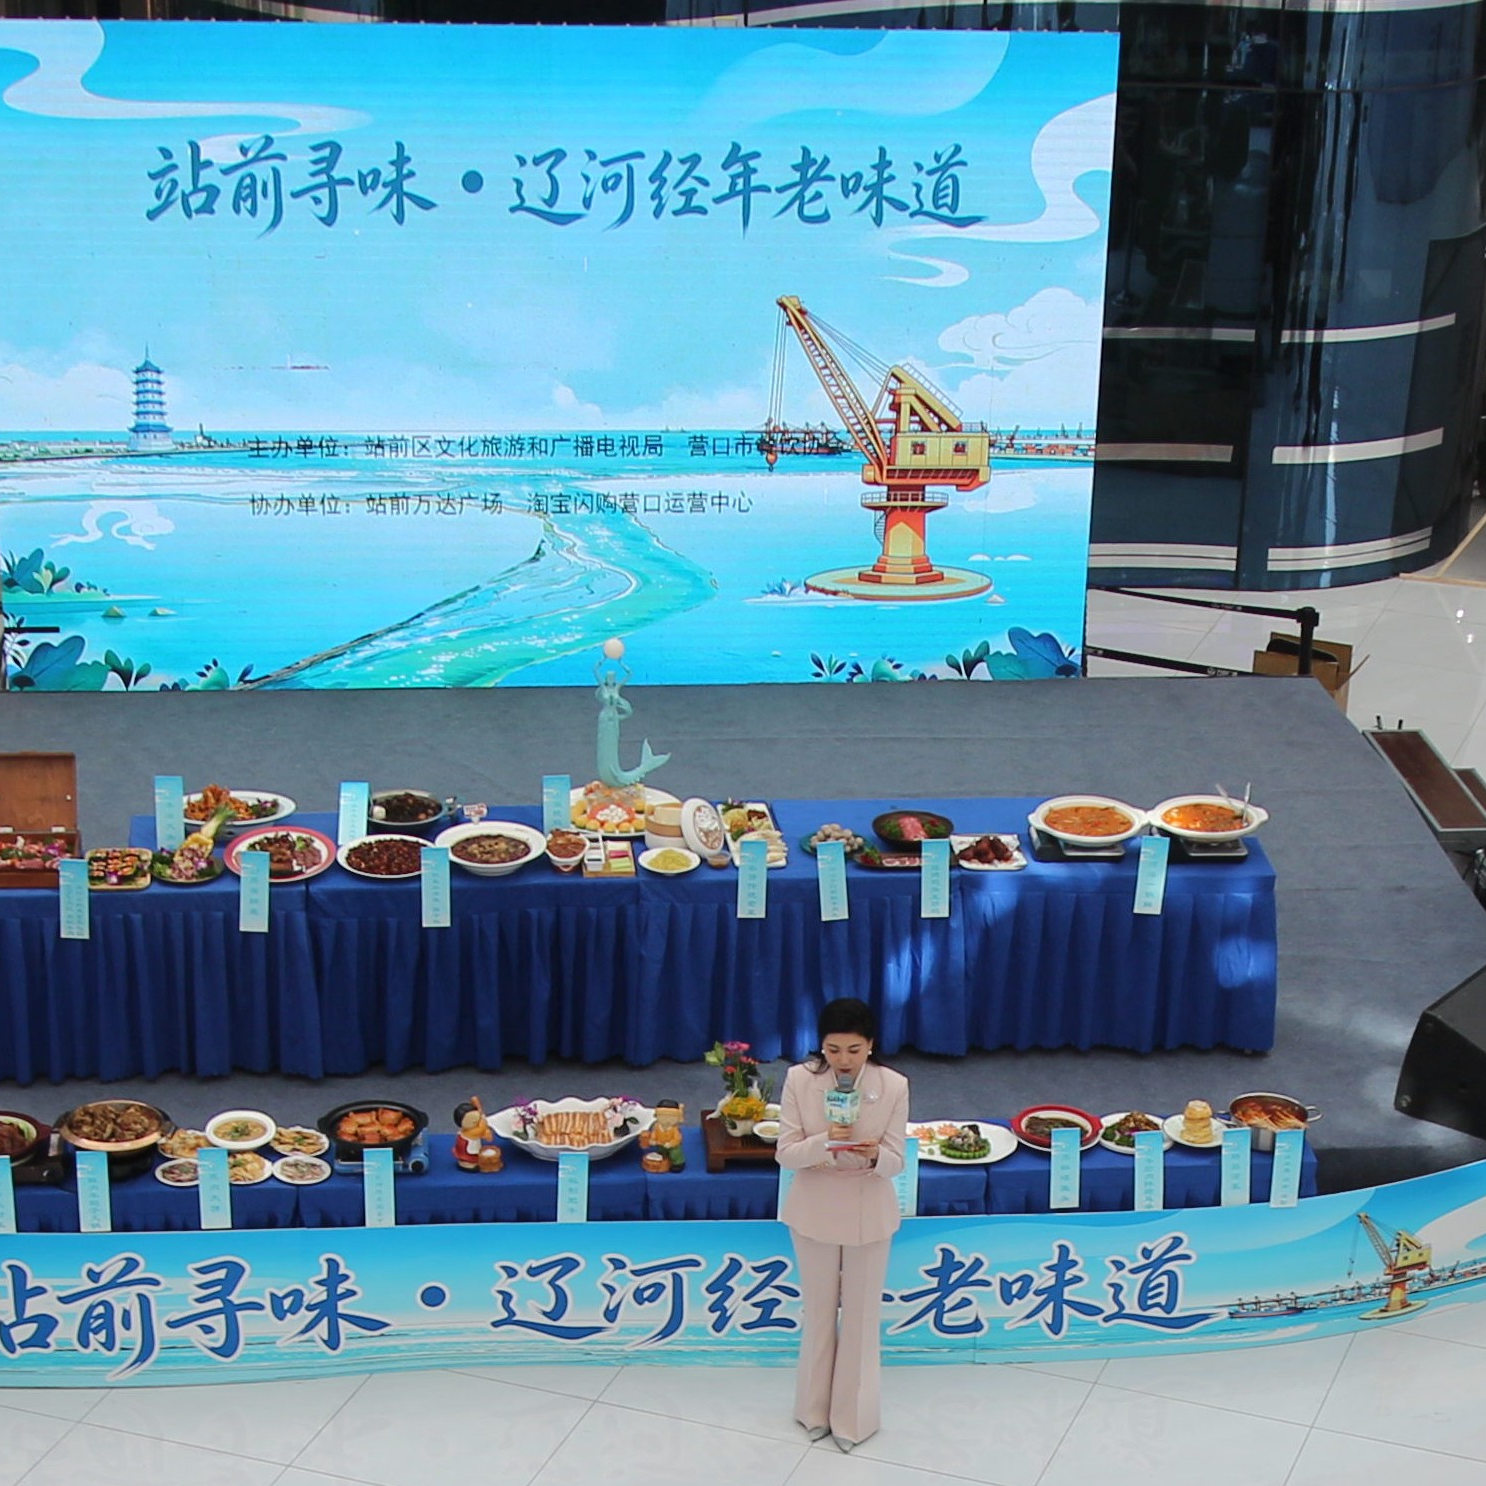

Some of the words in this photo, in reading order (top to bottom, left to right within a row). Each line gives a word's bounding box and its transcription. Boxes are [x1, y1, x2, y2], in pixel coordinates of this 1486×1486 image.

[146, 136, 988, 240] 站前寻味·辽河经年老味道
